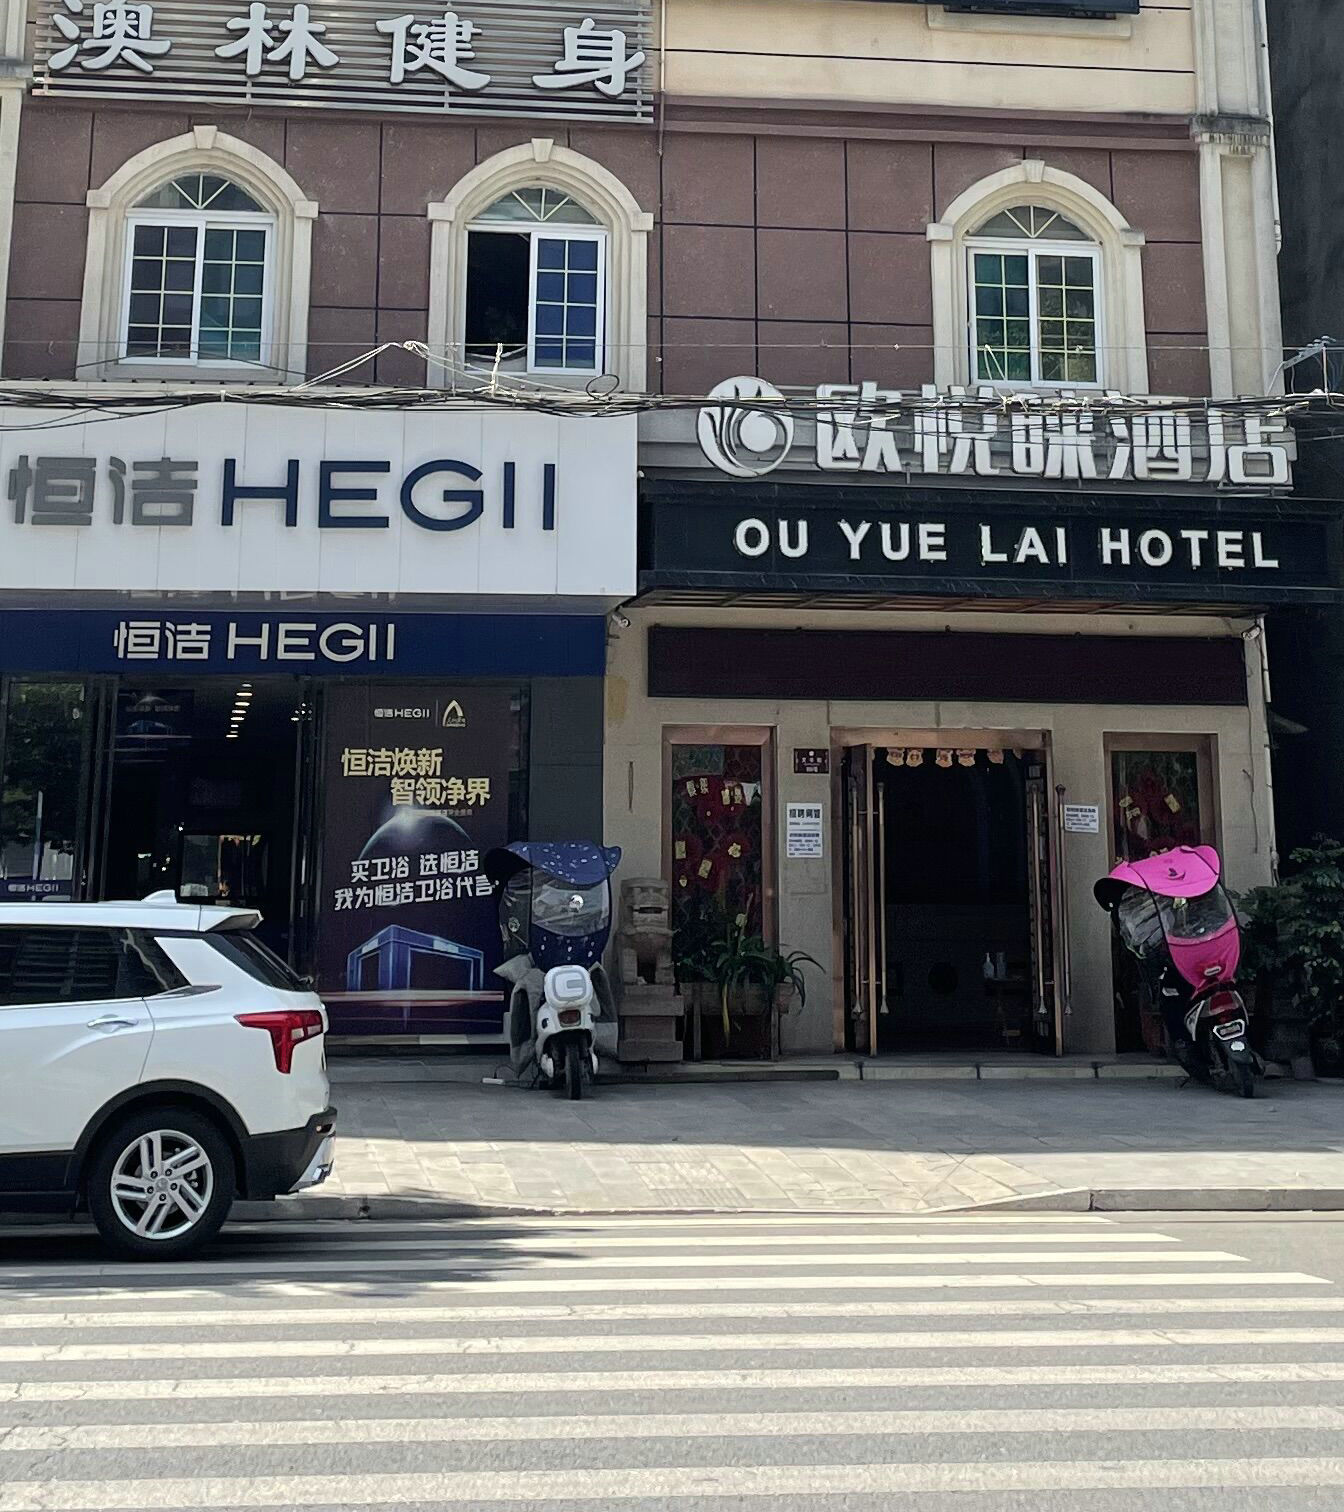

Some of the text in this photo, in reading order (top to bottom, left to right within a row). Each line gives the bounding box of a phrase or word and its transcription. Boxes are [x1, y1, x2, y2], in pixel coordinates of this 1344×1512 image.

[9, 455, 556, 532] 恒洁 HEGII
[734, 518, 1279, 569] OU YUE LAI HOTEL
[113, 620, 395, 662] 恒洁 HEGII
[341, 746, 444, 777] 恒洁焕新
[390, 776, 491, 807] 智领净界
[351, 849, 480, 883] 买卫浴 选恒洁
